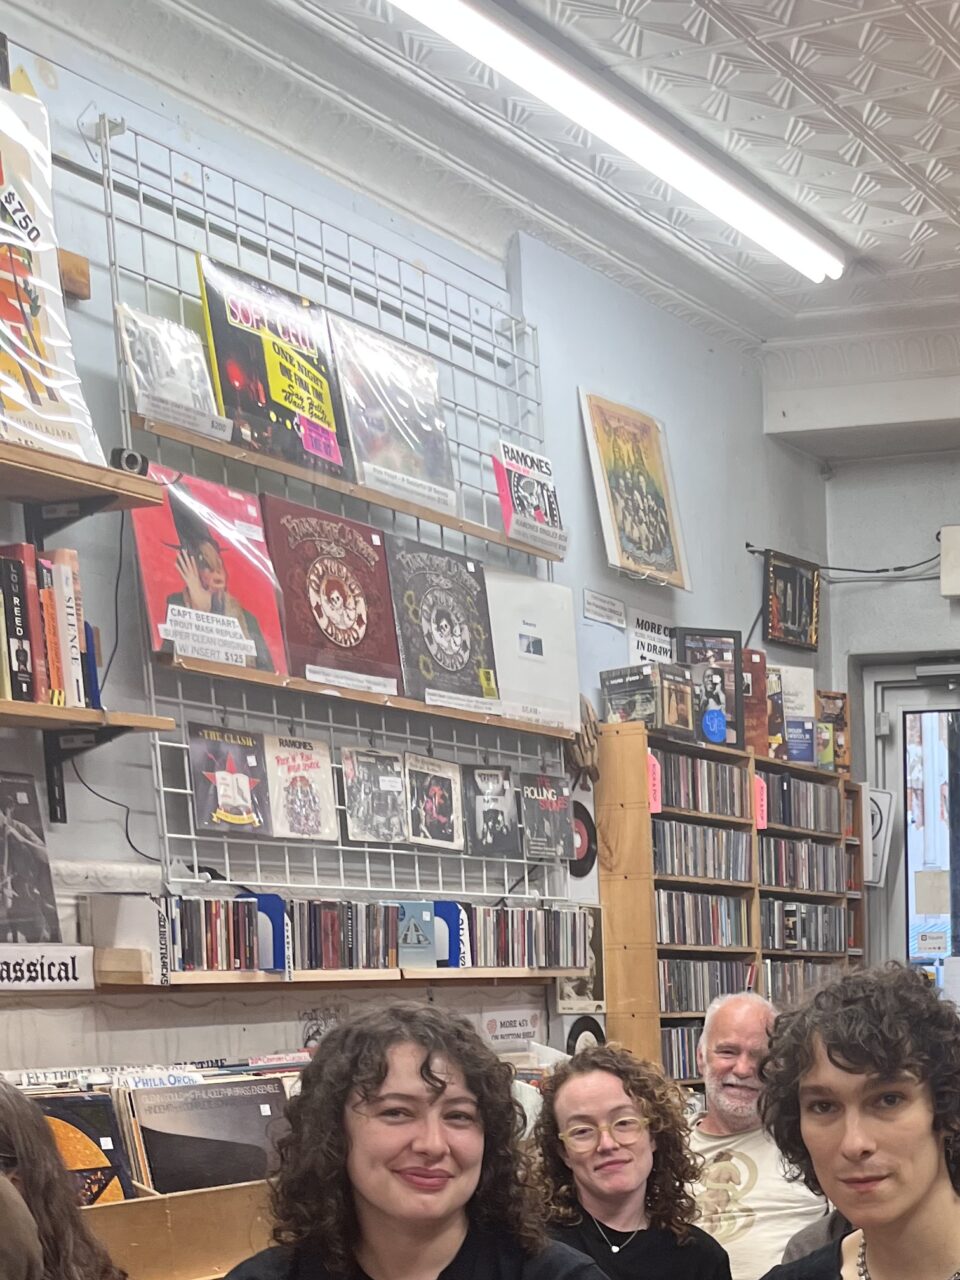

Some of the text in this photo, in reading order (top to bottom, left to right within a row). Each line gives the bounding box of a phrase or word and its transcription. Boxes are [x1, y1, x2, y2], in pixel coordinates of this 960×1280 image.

[4, 191, 41, 243] $750
[502, 443, 552, 477] RAMONES
[10, 562, 19, 593] LOU
[12, 596, 24, 636] REED
[635, 616, 662, 635] MORE
[65, 596, 80, 666] SILENCE
[225, 652, 244, 664] $125
[636, 639, 646, 652] IN
[224, 732, 253, 747] CLASH
[278, 738, 314, 751] RAMONES
[523, 786, 557, 801] ROLLING
[157, 908, 170, 986] SOUNDTRACKS
